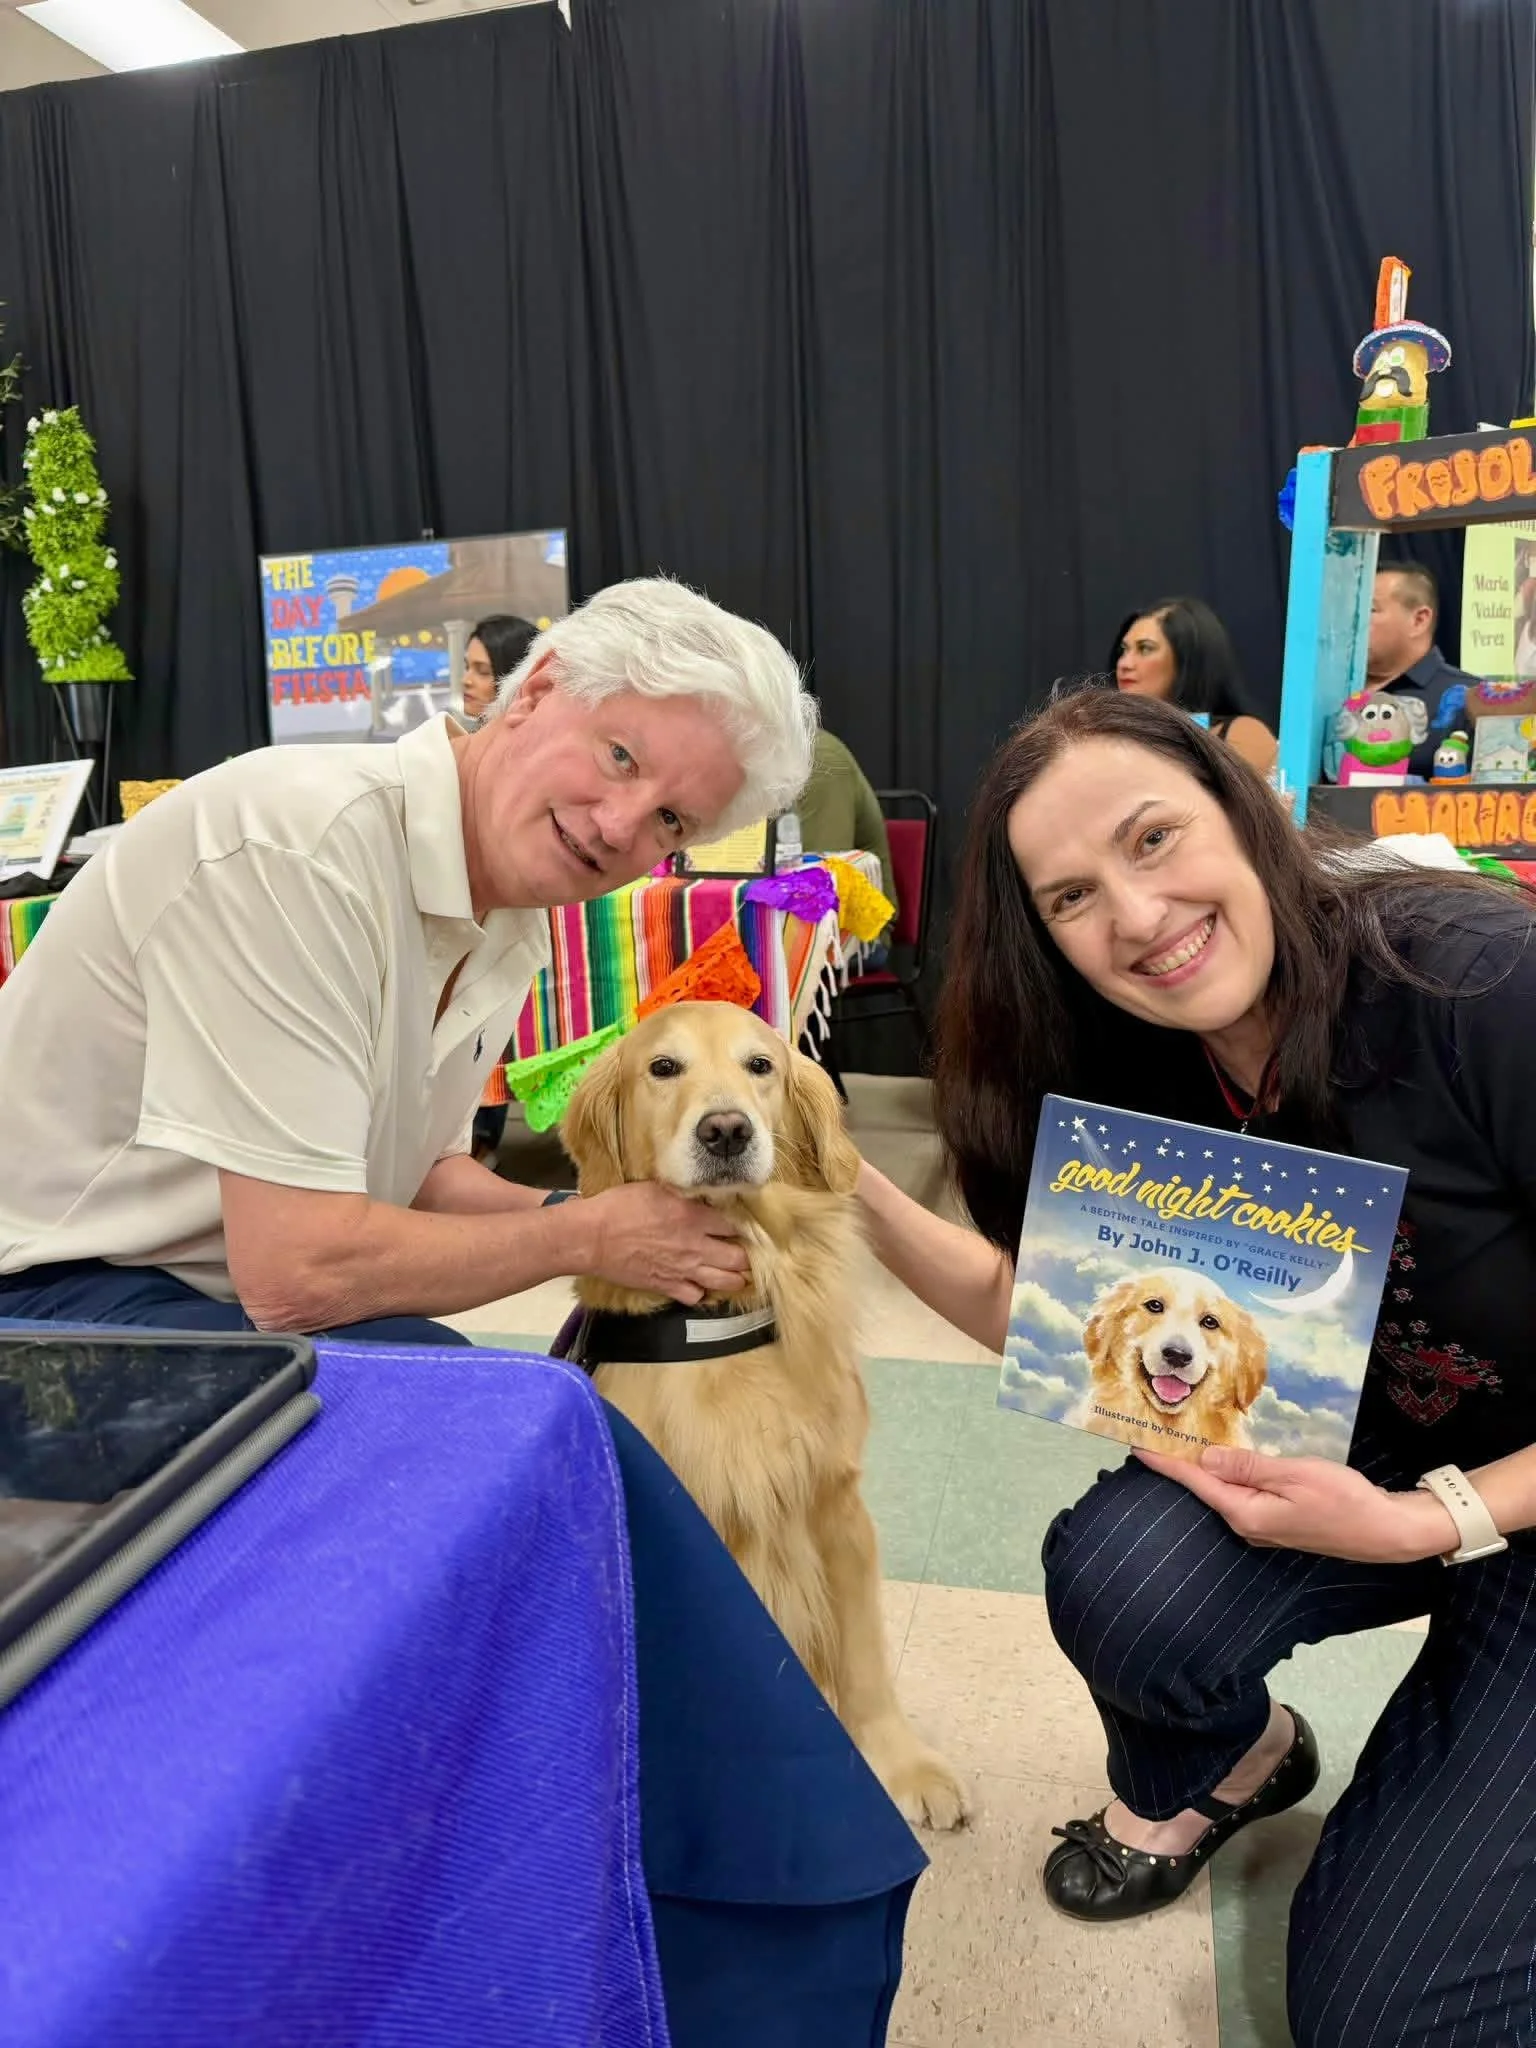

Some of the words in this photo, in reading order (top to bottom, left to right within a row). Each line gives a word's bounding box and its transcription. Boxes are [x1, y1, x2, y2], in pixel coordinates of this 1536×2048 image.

[267, 559, 314, 590] THE
[271, 598, 323, 629] DAY
[271, 631, 376, 669] BEFORE
[271, 670, 371, 705] FIESTA
[1049, 1160, 1140, 1197] good
[1135, 1175, 1254, 1220] night
[1232, 1202, 1372, 1253] cookies
[1080, 1204, 1087, 1212] A
[1090, 1206, 1137, 1225] BEDTIME
[1141, 1219, 1166, 1232] TALE
[1169, 1225, 1222, 1245] INSPIRED
[1226, 1239, 1241, 1249] BY
[1098, 1225, 1125, 1248] By
[1129, 1233, 1182, 1260] John
[1187, 1248, 1205, 1266] J.
[1213, 1254, 1302, 1292] O'Reilly
[1094, 1405, 1148, 1428] Illustrated
[1151, 1423, 1164, 1434] by
[1166, 1427, 1198, 1443] Daryn
